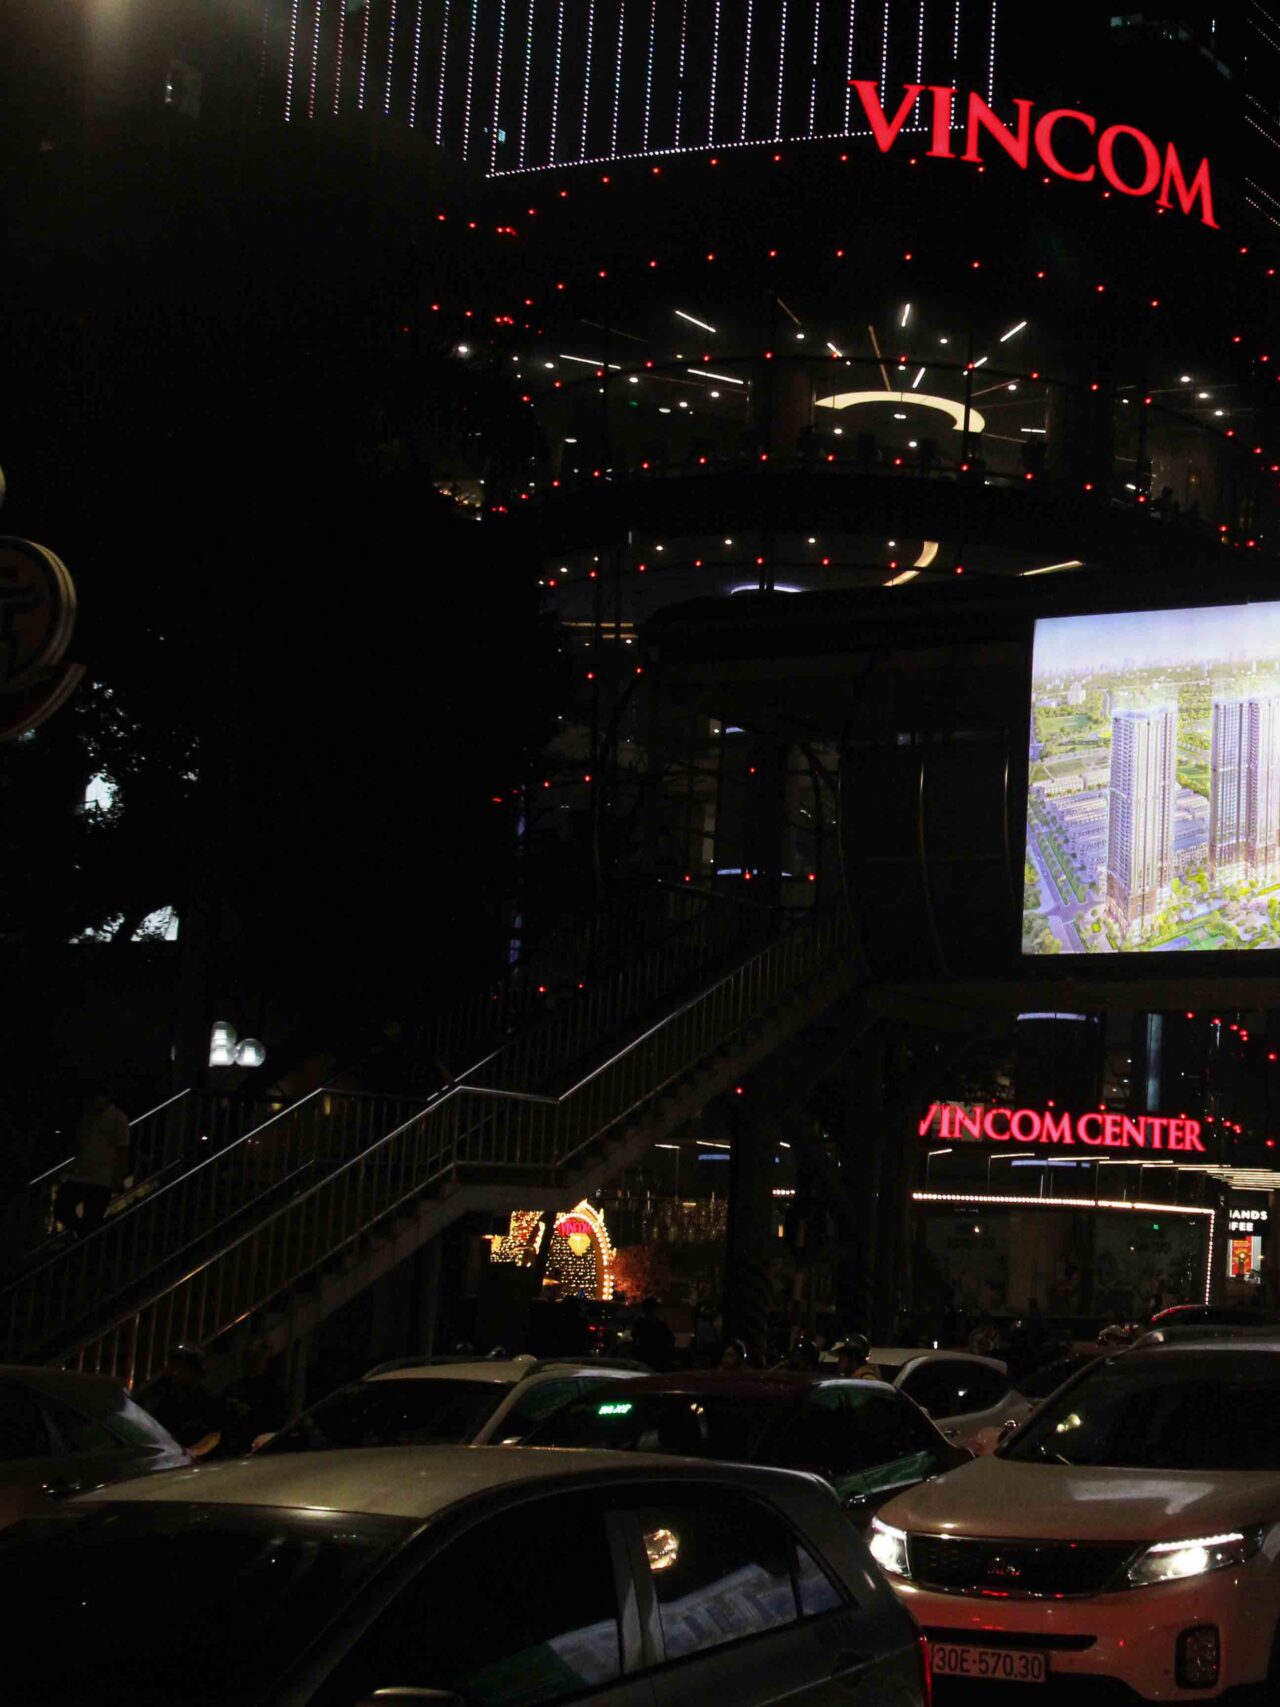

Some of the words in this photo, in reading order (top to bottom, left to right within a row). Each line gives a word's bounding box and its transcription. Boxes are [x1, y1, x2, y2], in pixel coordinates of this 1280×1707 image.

[848, 80, 1220, 229] VINCOM
[1077, 1113, 1206, 1151] CENTER
[1228, 1221, 1254, 1232] FEE
[1229, 1209, 1268, 1221] ANDS
